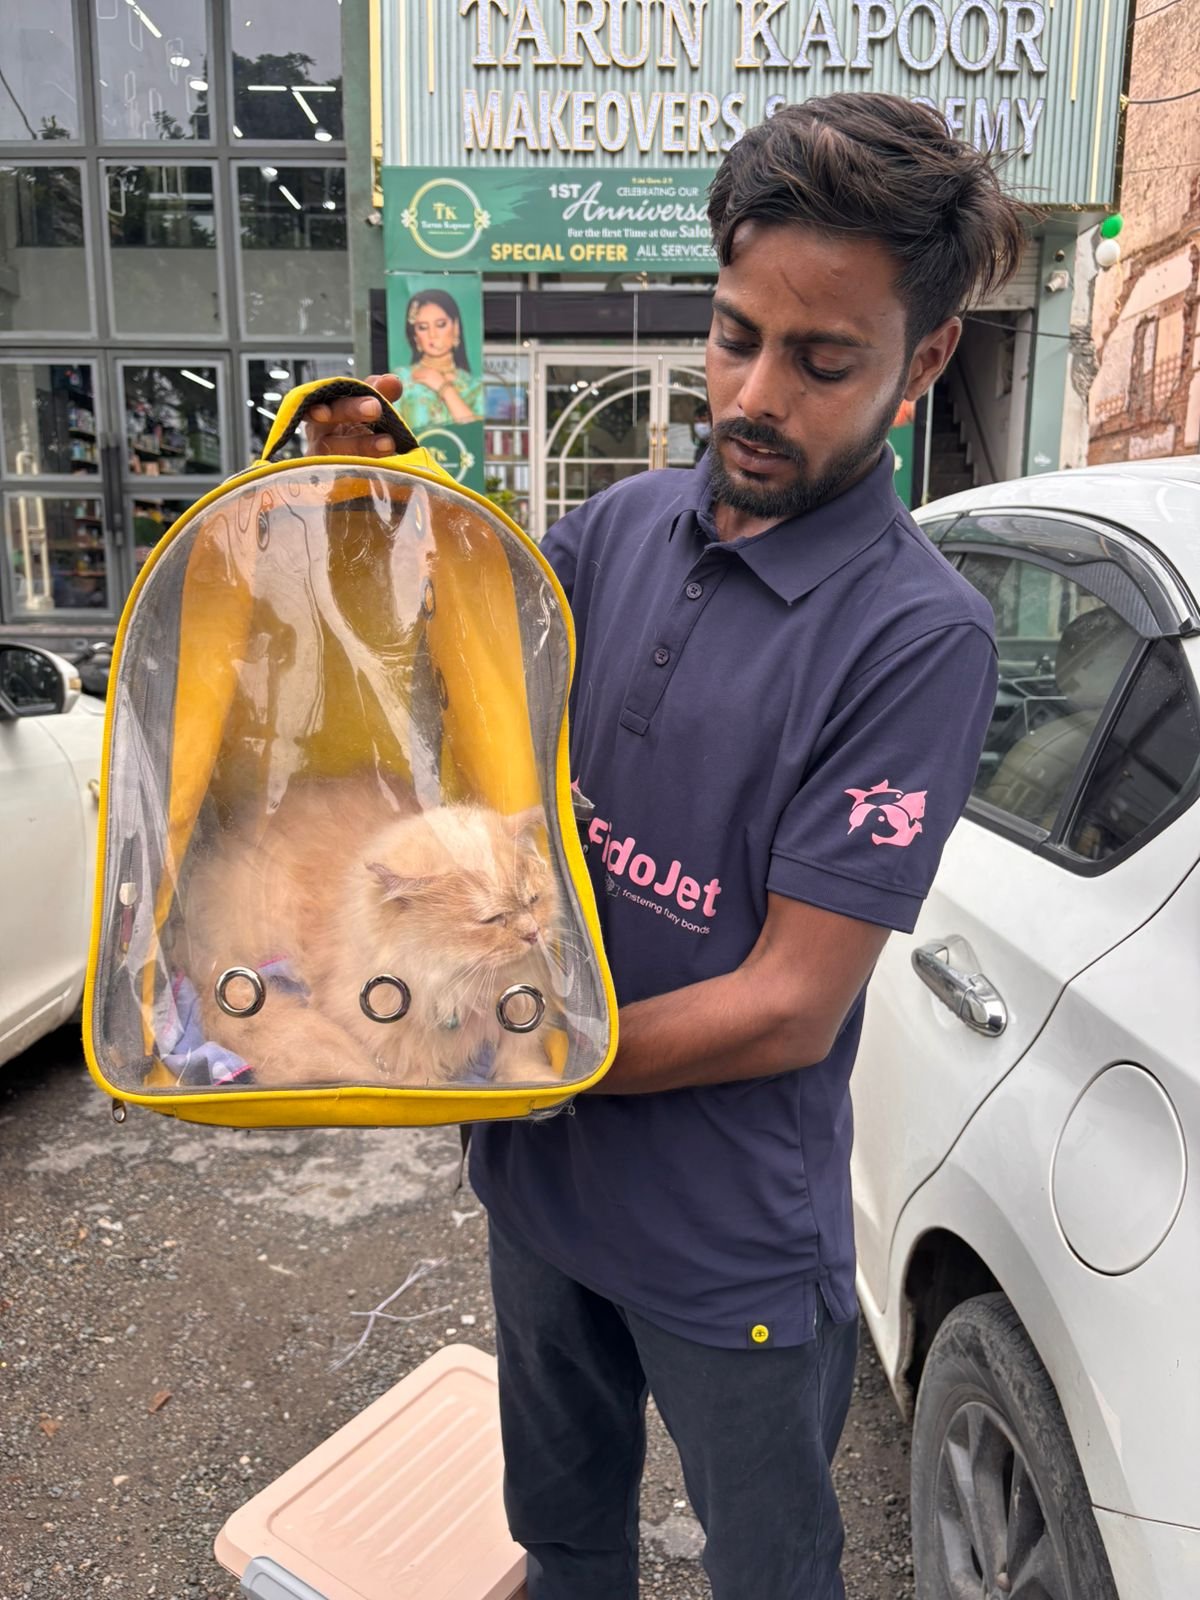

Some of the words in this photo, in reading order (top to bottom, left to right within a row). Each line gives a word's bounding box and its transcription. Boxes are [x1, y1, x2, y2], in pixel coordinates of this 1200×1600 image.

[459, 0, 706, 67] TARUN
[734, 0, 1048, 73] KAPOOR
[463, 89, 746, 153] MAKEOVERS
[549, 183, 582, 198] 1ST
[616, 187, 677, 197] CELEBRATING
[678, 187, 699, 197] OUR
[568, 228, 583, 238] For
[585, 227, 600, 238] the
[623, 228, 647, 238] Time
[648, 229, 659, 238] at
[491, 243, 565, 261] SPECIAL
[569, 244, 628, 262] OFFER
[637, 245, 658, 256] ALL
[588, 817, 721, 917] FidoJet
[622, 888, 663, 914] fostering
[663, 907, 680, 925] furry
[680, 918, 710, 934] bonds
